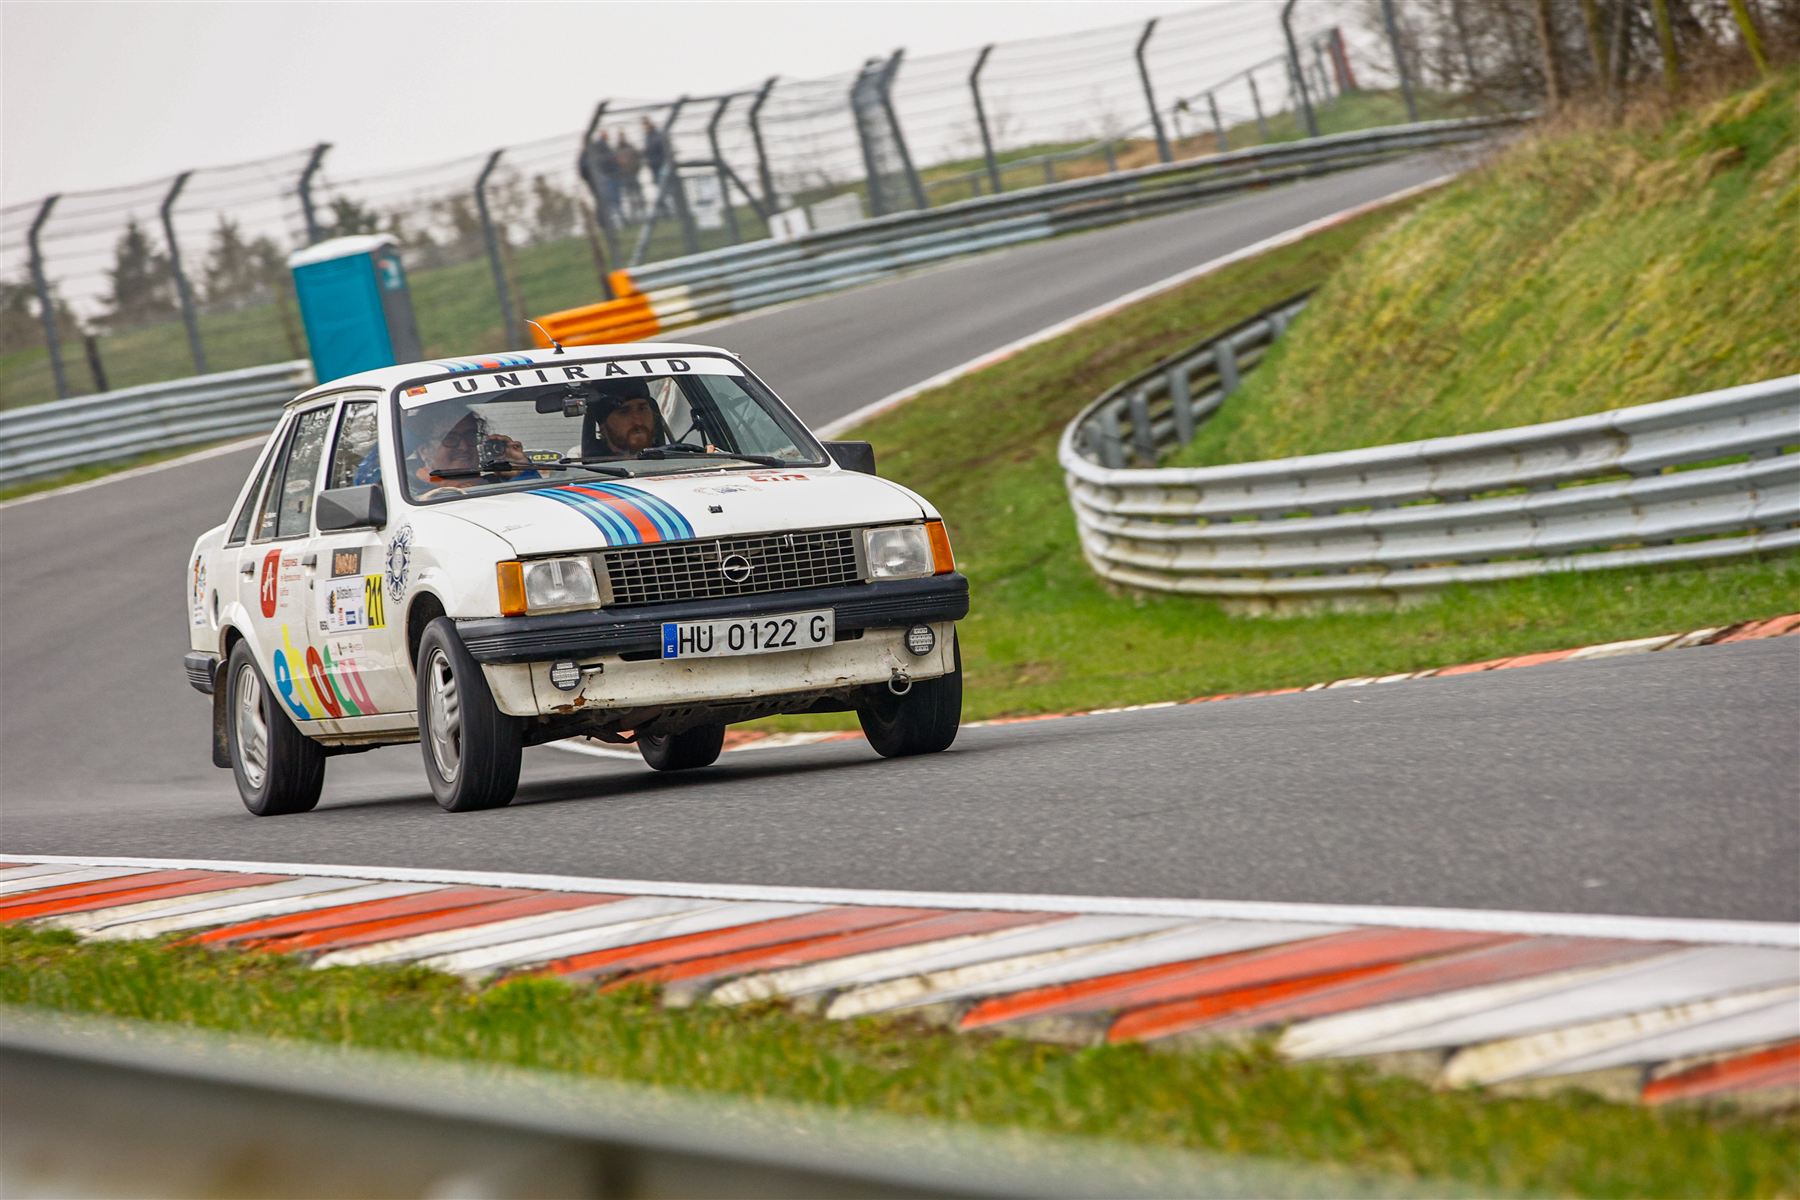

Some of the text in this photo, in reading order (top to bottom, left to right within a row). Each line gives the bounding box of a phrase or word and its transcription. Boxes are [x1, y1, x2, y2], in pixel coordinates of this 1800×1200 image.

[453, 359, 691, 394] UNIRAID
[365, 576, 385, 626] 211
[667, 645, 674, 653] E
[679, 616, 826, 653] HU 0122 G
